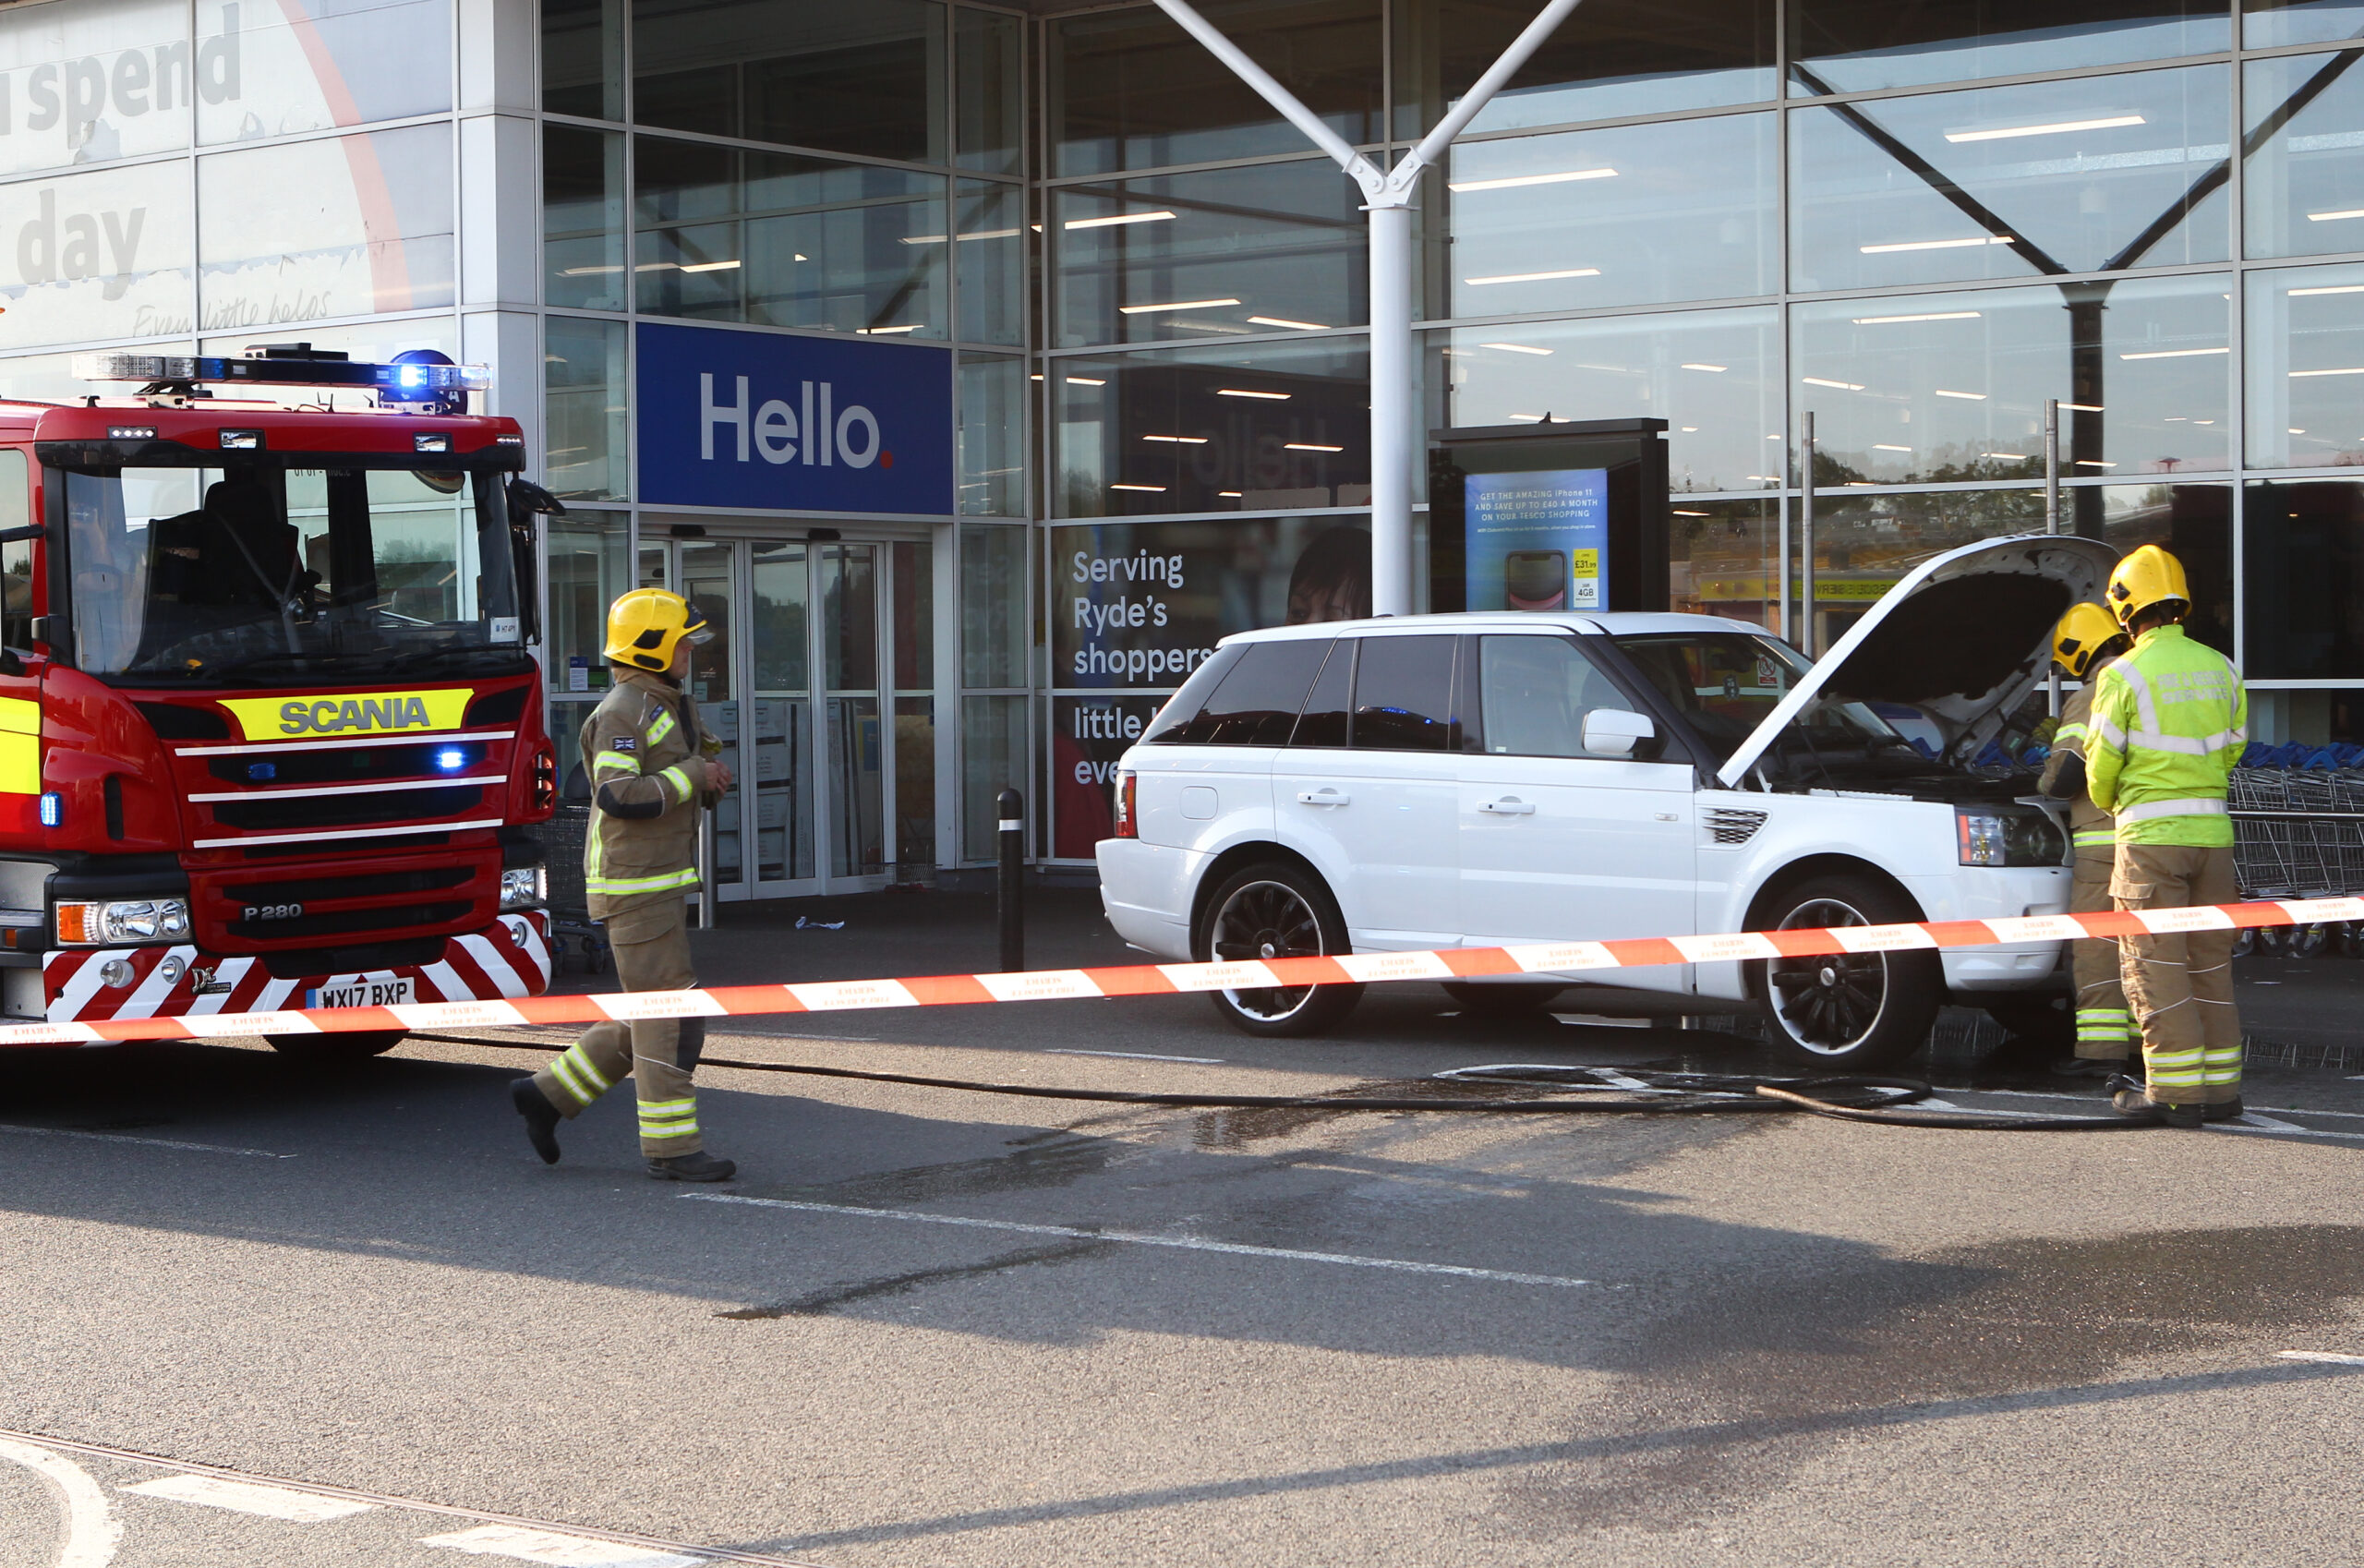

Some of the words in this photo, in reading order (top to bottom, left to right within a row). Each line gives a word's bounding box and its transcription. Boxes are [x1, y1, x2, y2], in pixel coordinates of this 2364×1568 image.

[28, 2, 240, 150] spend
[17, 187, 147, 302] day
[269, 289, 332, 324] helps
[1498, 492, 1514, 501] THE
[1515, 490, 1552, 499] AMAZING
[1494, 502, 1514, 511] SAVE
[1515, 501, 1526, 510] UP
[1569, 499, 1598, 507] MONTH
[1481, 513, 1493, 522] ON
[1496, 513, 1517, 521] YOUR
[1520, 512, 1546, 520] TESCO
[1548, 510, 1589, 518] SHOPPING
[1073, 549, 1184, 589] Serving
[1578, 588, 1594, 597] 4GB
[1074, 595, 1168, 636] Ryde’s
[2162, 688, 2229, 704] SERVICE
[279, 697, 430, 734] SCANIA
[1074, 707, 1141, 739] little
[245, 907, 259, 922] P
[260, 904, 302, 921] 280
[1549, 949, 1583, 959] SERVICE
[1381, 959, 1415, 967] SERVICE
[1206, 968, 1241, 976] SERVICE
[1025, 977, 1062, 986] SERVICE
[322, 986, 366, 1009] WX17
[371, 982, 408, 1007] BXP
[838, 987, 876, 996] SERVICE
[644, 996, 683, 1006] SERVICE
[442, 1007, 482, 1016] SERVICE
[231, 1016, 273, 1026] SERVICE
[13, 1027, 57, 1036] SERVICE
